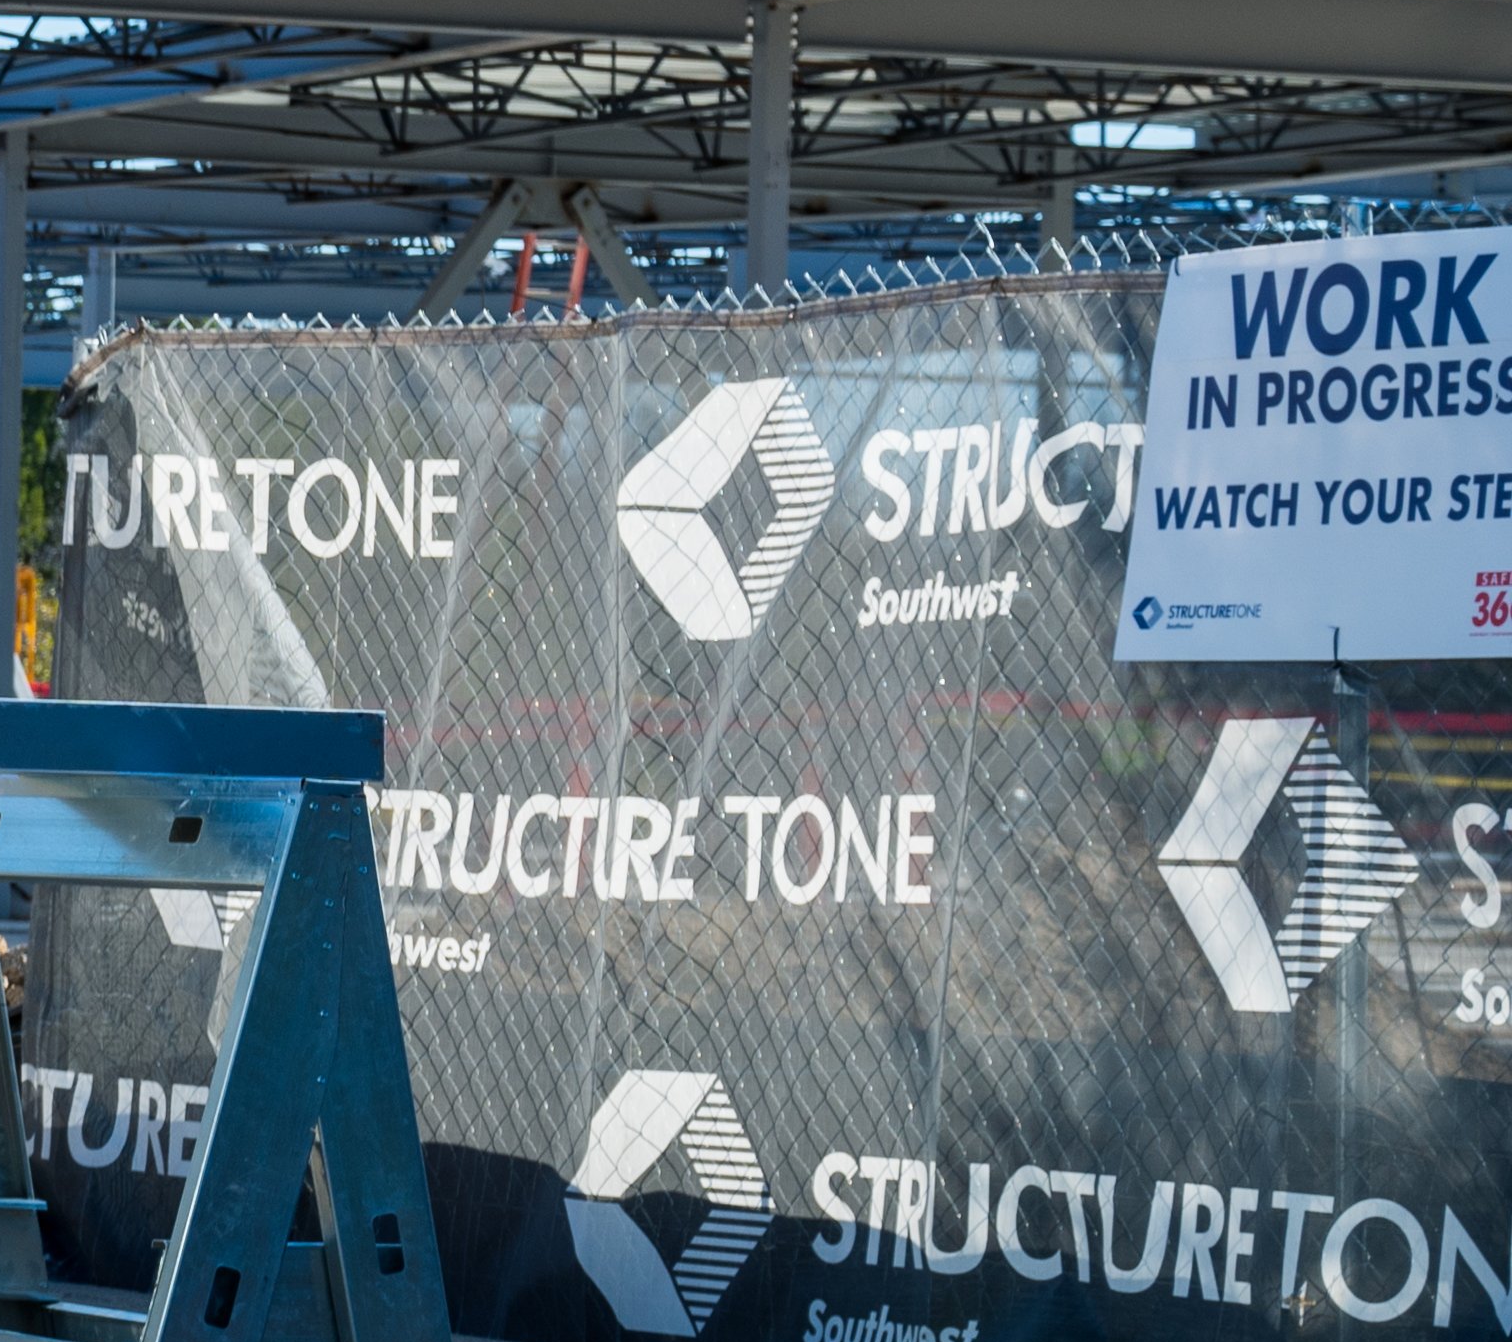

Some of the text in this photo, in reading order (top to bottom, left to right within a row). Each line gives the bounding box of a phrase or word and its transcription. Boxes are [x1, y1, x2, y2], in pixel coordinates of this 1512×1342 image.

[1231, 253, 1498, 360] WORK
[1187, 374, 1238, 430] IN
[1154, 482, 1299, 530] WATCH
[1315, 476, 1432, 525] YOUR
[858, 571, 1019, 628] Southwest
[1482, 572, 1512, 586] SAF
[1472, 590, 1512, 627] 36
[724, 793, 936, 906] TONE
